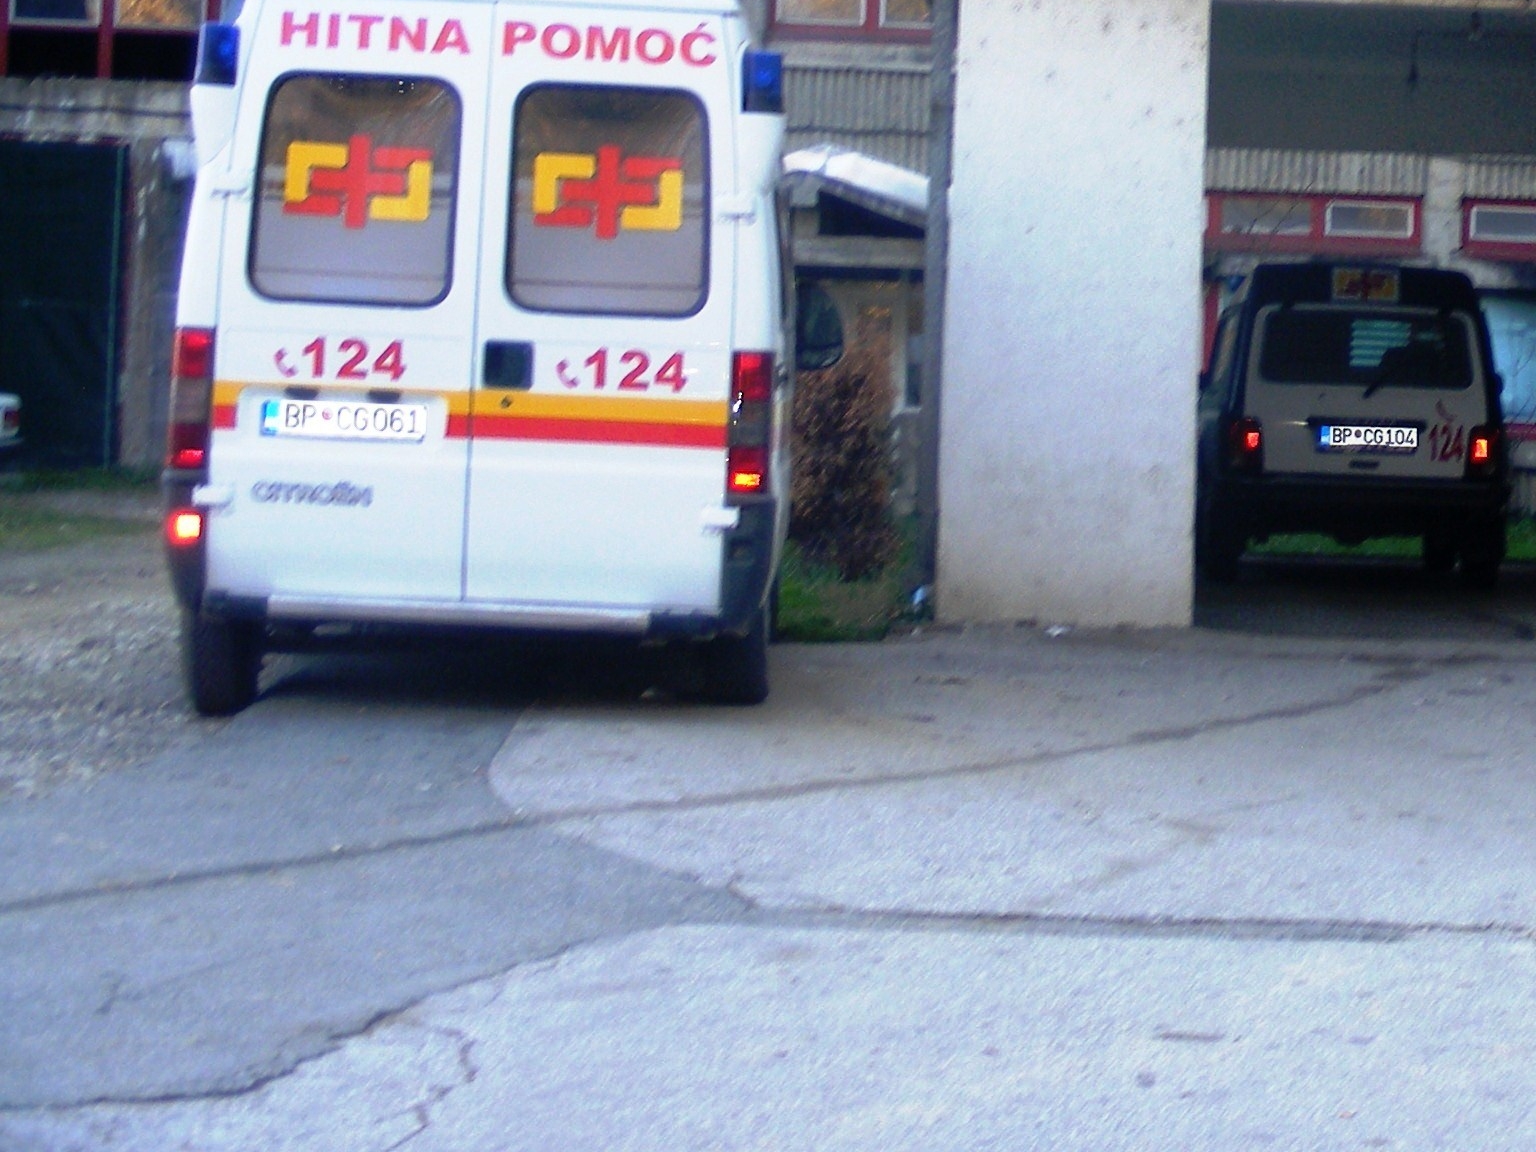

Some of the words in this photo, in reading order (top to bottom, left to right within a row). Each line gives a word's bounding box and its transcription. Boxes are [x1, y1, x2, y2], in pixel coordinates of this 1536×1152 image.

[280, 11, 472, 55] HITNA
[501, 20, 718, 67] POMOĆ
[302, 335, 407, 382] 124
[584, 346, 689, 392] 124
[1428, 422, 1465, 462] 124
